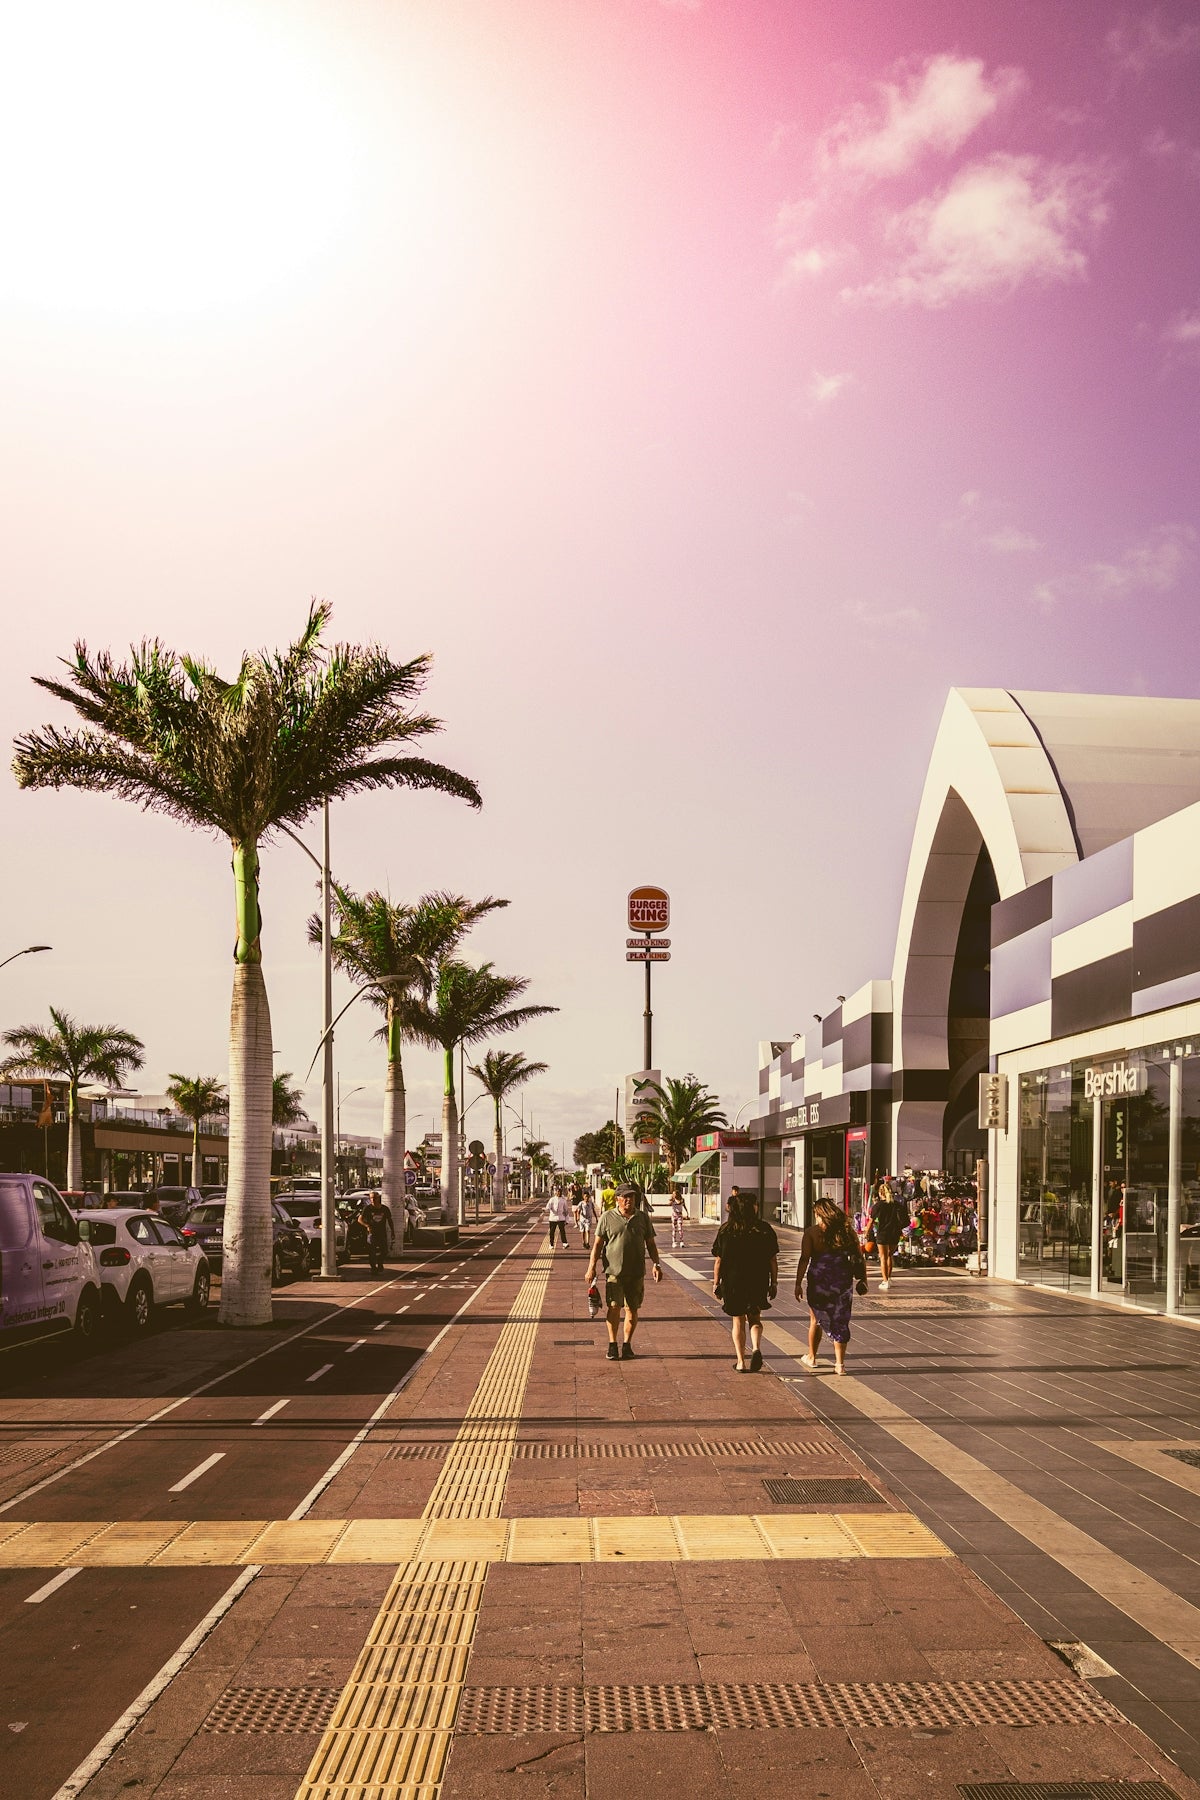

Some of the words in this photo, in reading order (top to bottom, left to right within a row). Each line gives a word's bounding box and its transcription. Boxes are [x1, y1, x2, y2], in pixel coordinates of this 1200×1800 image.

[630, 901, 667, 909] BURGER
[630, 909, 667, 921] KING
[1084, 1061, 1137, 1098] Bershka
[986, 1076, 999, 1126] Bershka
[37, 1301, 58, 1319] Integral
[58, 1300, 65, 1313] 10
